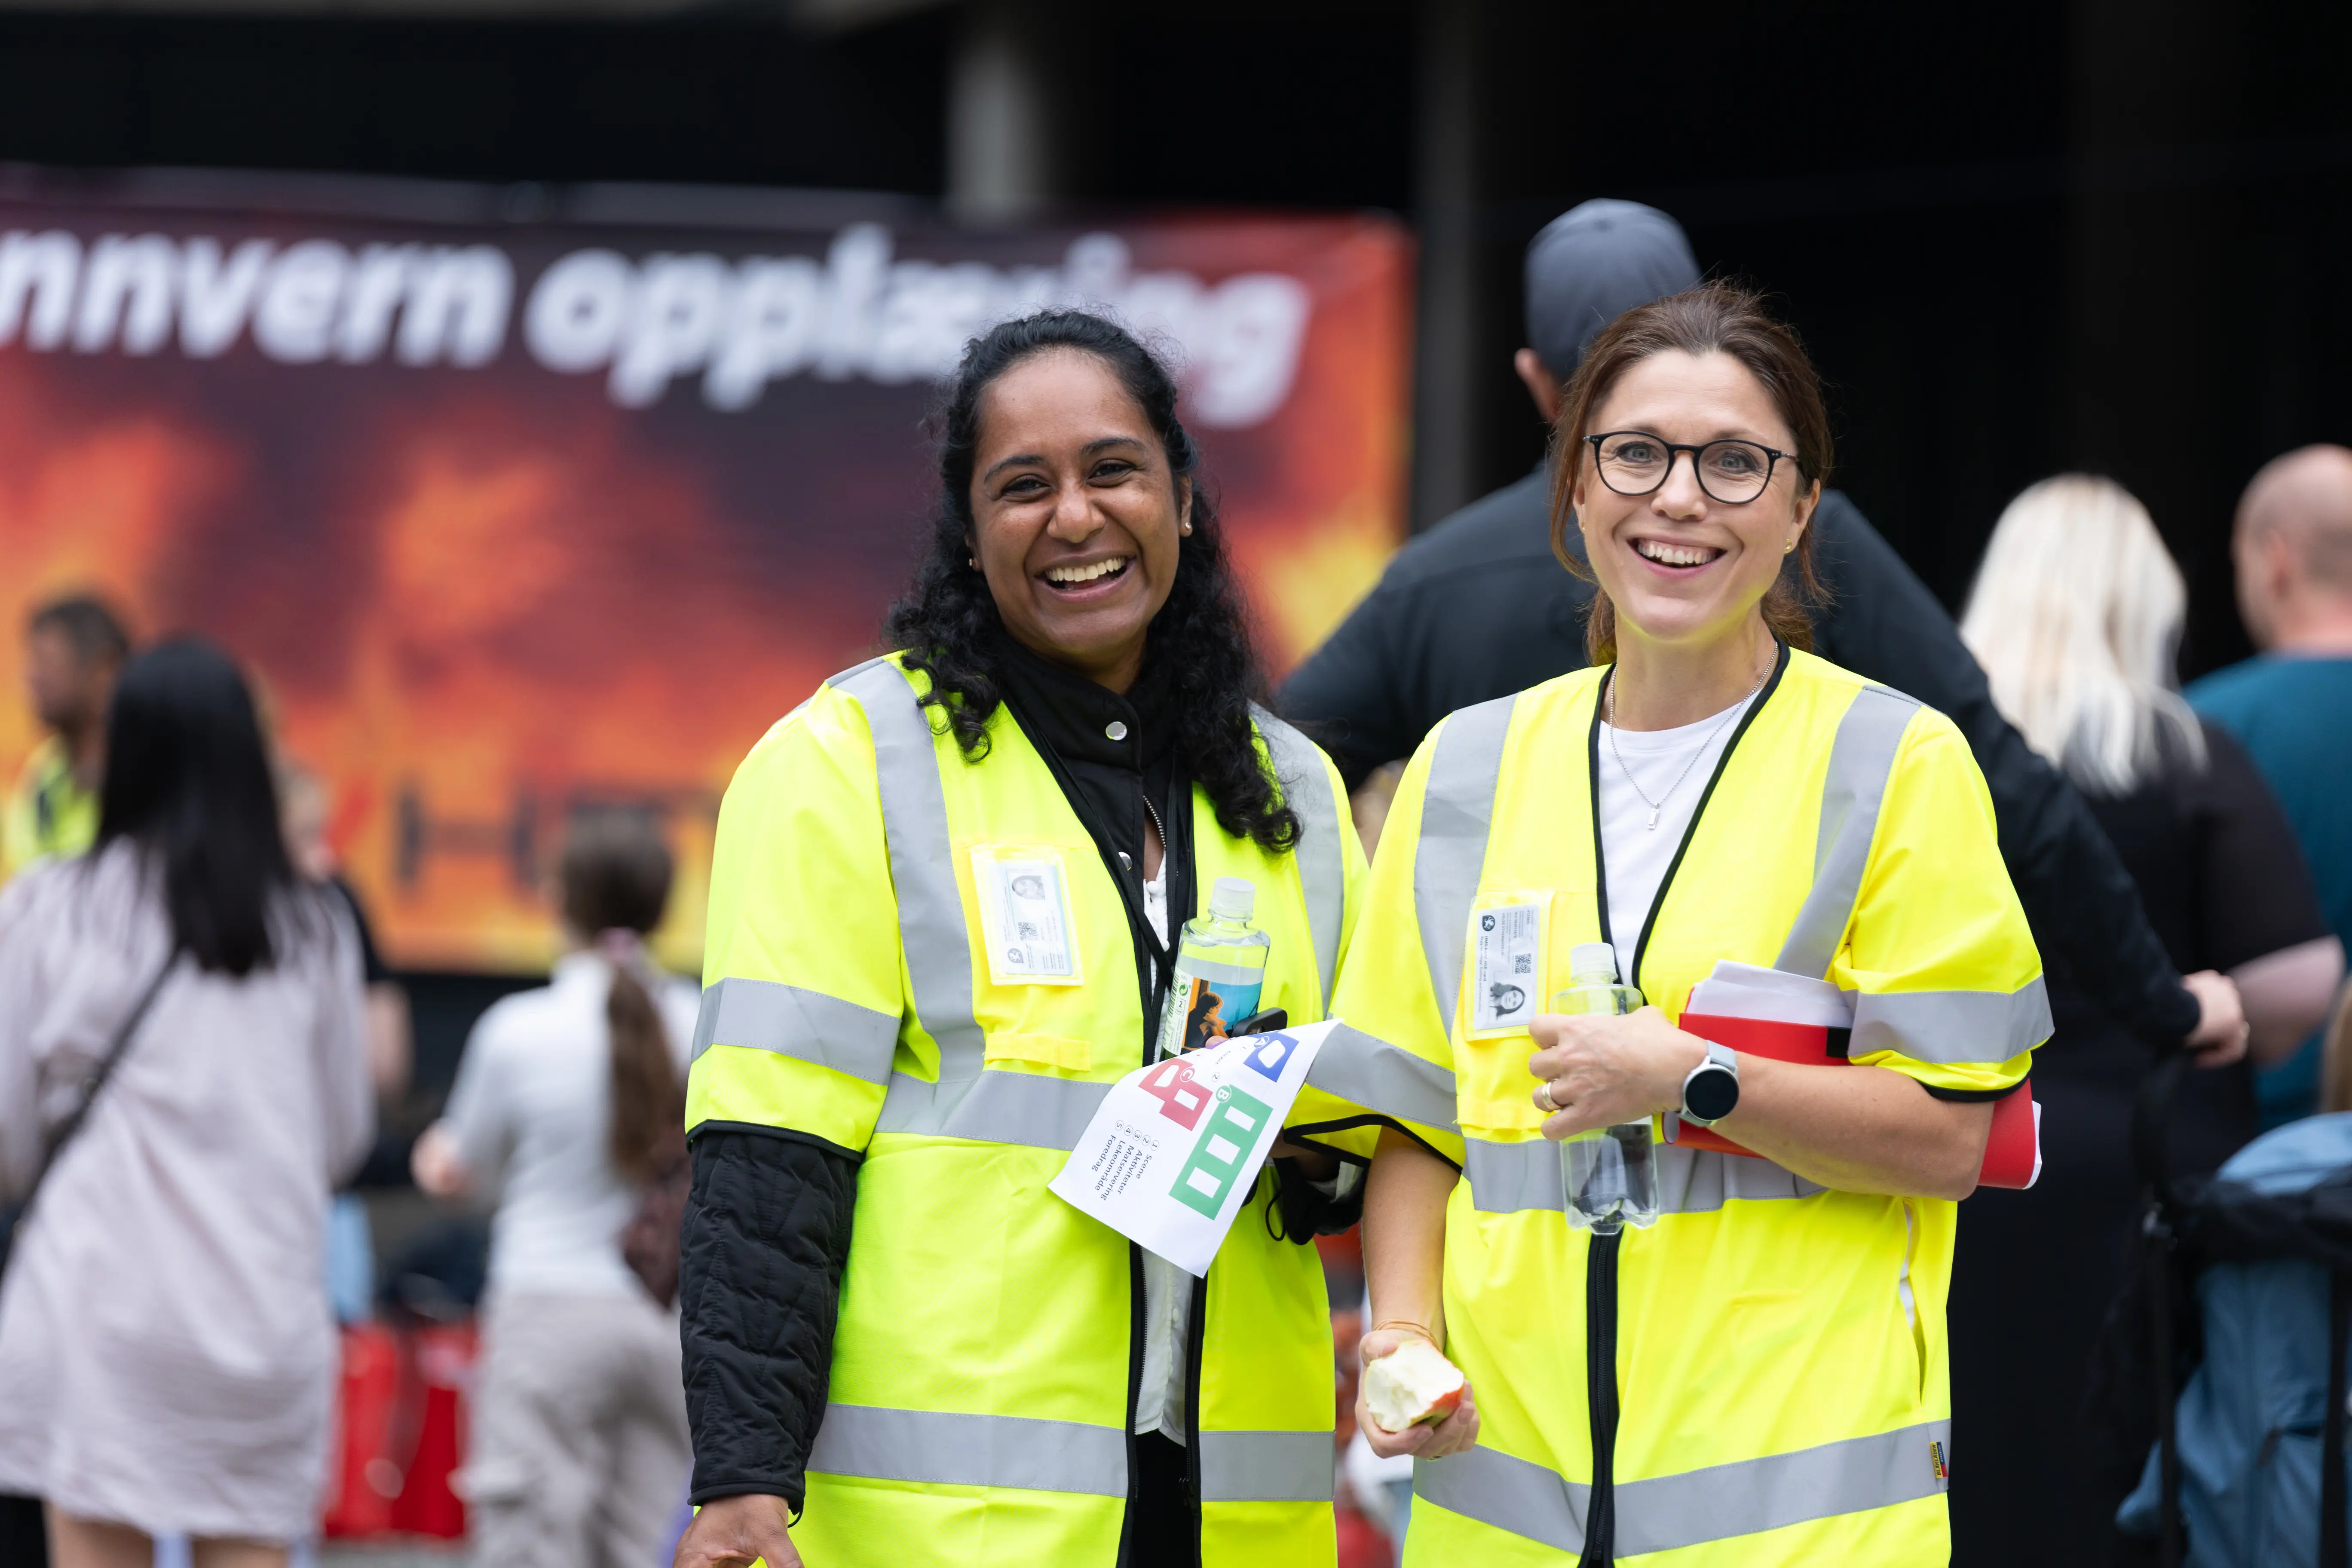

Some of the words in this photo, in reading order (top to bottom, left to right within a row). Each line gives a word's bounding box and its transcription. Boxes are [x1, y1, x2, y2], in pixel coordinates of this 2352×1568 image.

[1217, 1088, 1230, 1100] B
[1091, 1135, 1116, 1172] Foredrag
[1094, 1140, 1126, 1191] Lekeområde
[1100, 1145, 1134, 1201] Matservering
[1117, 1149, 1142, 1195] Aktiviteter
[1136, 1154, 1152, 1179] Scene
